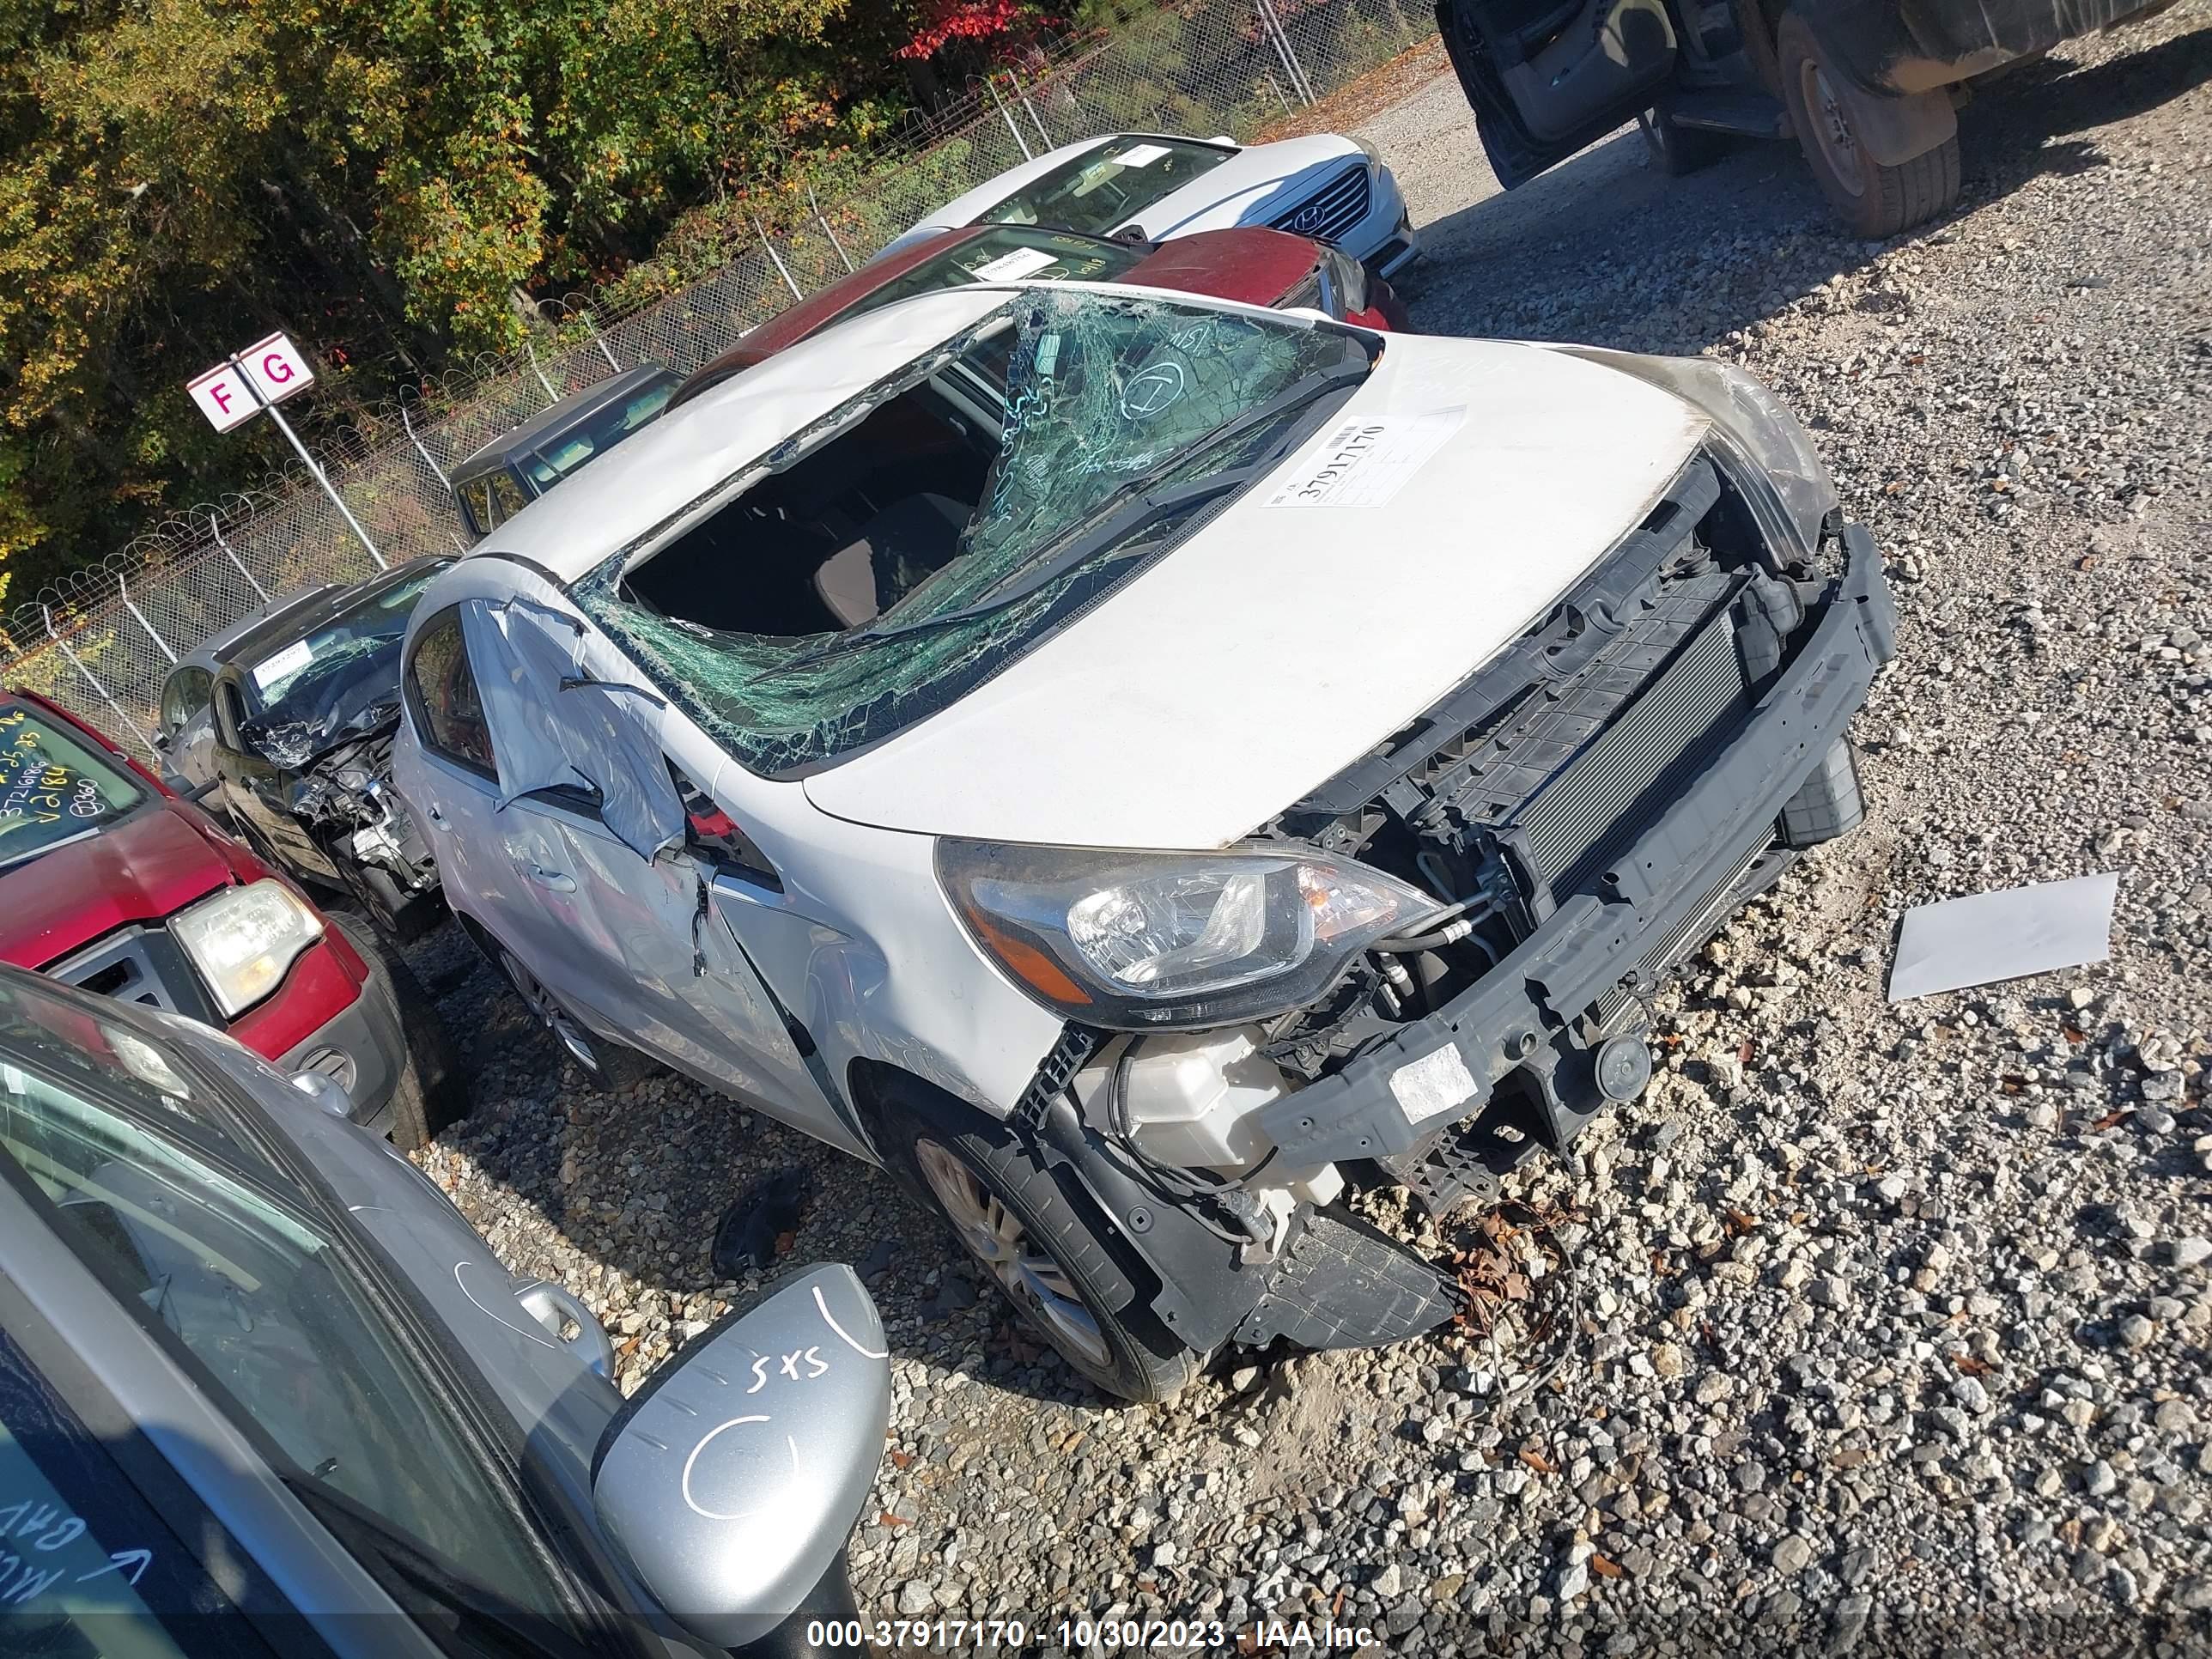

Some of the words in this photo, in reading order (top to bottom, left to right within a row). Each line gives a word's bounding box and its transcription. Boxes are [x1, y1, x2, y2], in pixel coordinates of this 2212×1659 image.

[263, 353, 295, 384] G
[210, 383, 233, 415] F
[1297, 426, 1385, 499] 37917170
